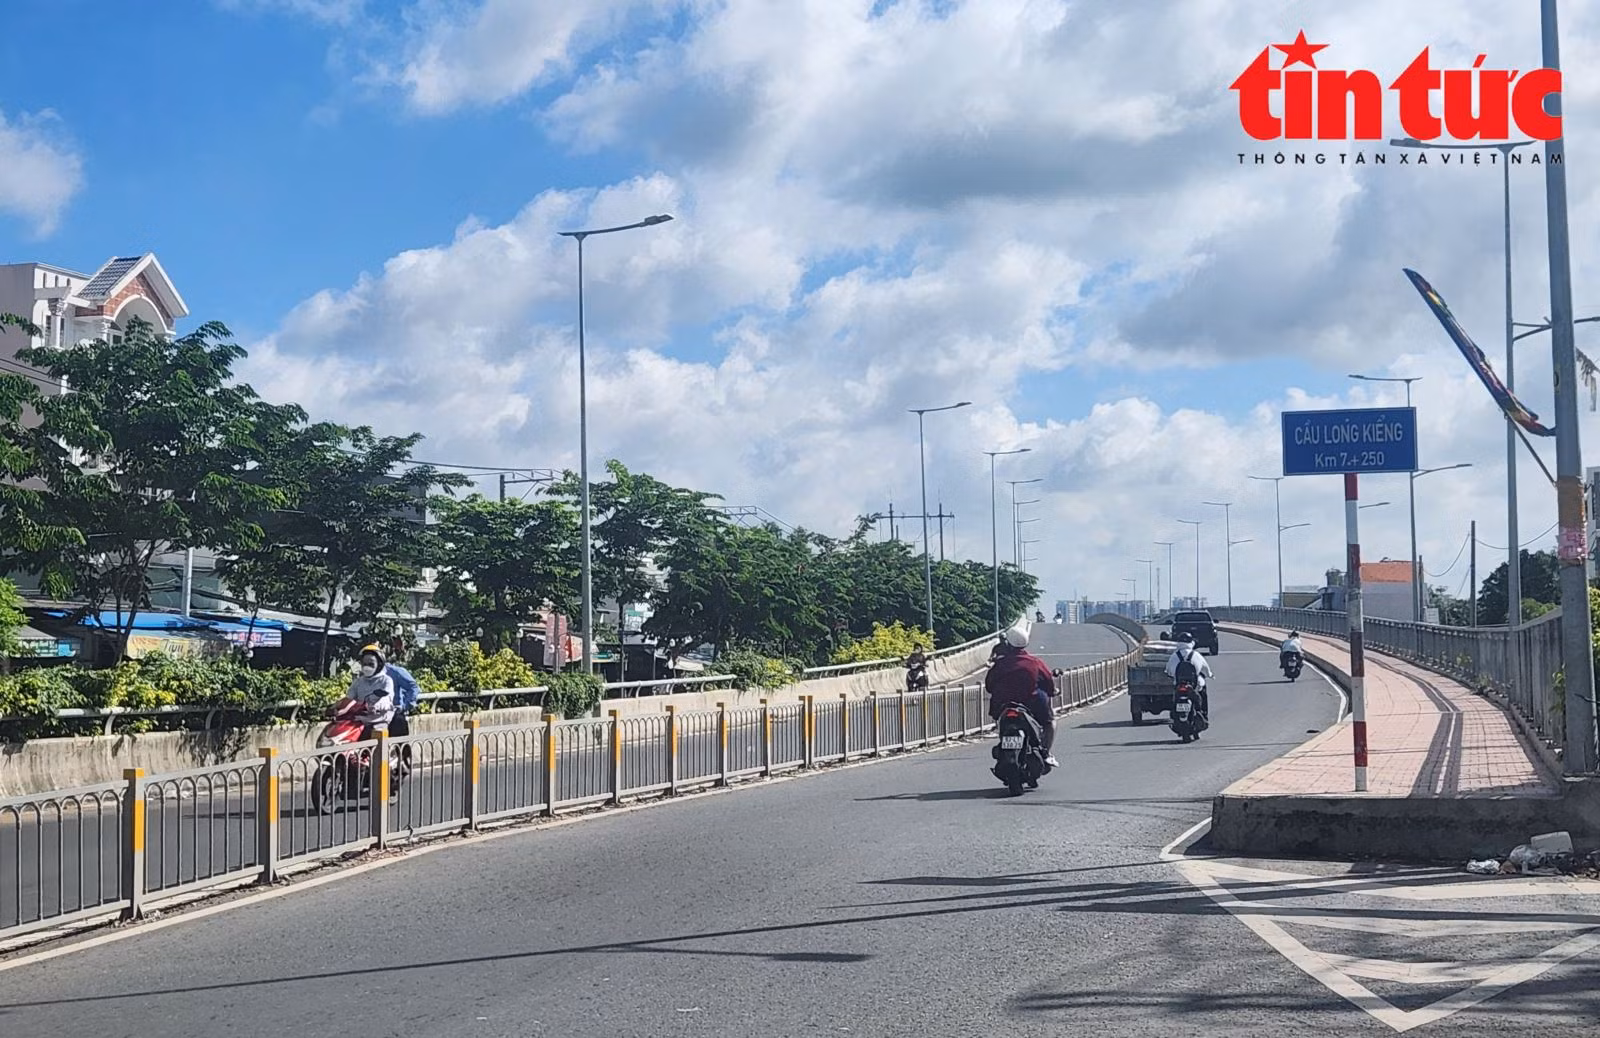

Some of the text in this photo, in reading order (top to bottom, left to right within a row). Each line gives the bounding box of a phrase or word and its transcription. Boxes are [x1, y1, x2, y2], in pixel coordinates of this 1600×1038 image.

[1294, 419, 1320, 445] CẦU
[1363, 414, 1403, 443] KIỂNG
[1314, 453, 1337, 468] Km
